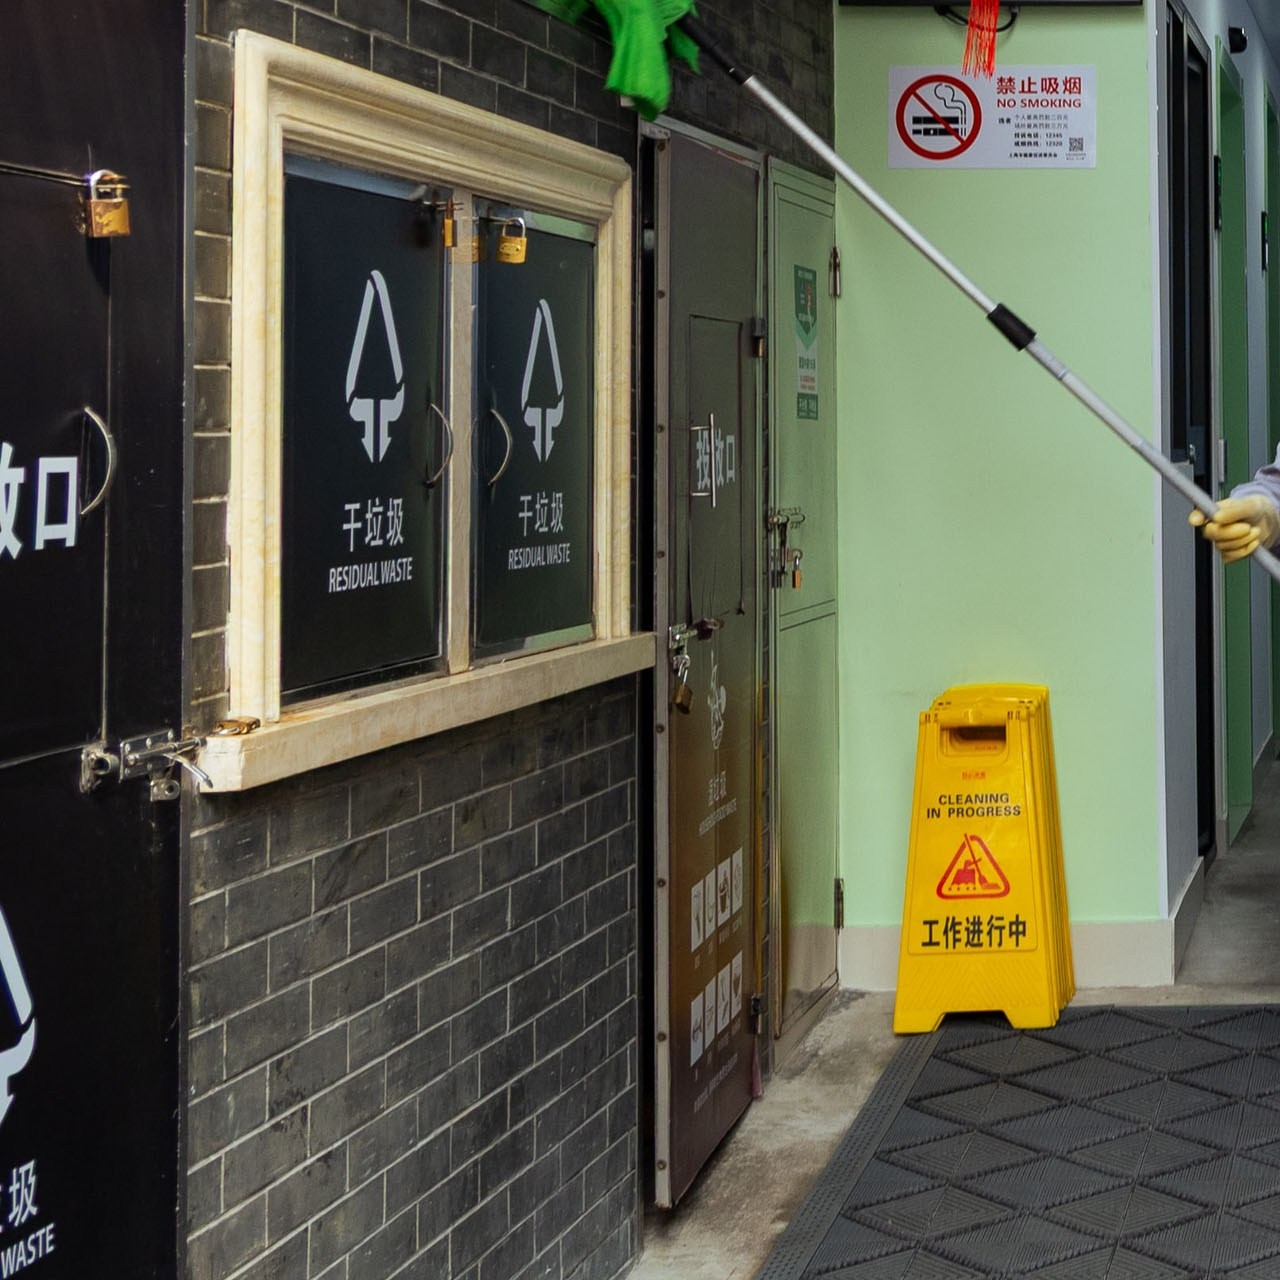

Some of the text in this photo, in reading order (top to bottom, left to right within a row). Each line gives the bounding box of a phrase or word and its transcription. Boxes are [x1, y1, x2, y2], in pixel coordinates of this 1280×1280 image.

[996, 76, 1082, 95] 禁止吸烟
[997, 99, 1082, 108] NO SMOKING
[342, 497, 404, 552] 干垃圾
[518, 490, 563, 537] 干垃圾
[508, 542, 571, 570] RESIDUAL WASTE
[328, 556, 413, 593] RESIDUAL WASTE
[927, 805, 1021, 819] IN PROGRESS
[938, 793, 1009, 805] CLEANING
[921, 913, 1026, 949] 工作进行中
[0, 1160, 38, 1232] 圾
[0, 1222, 55, 1279] WASTE
